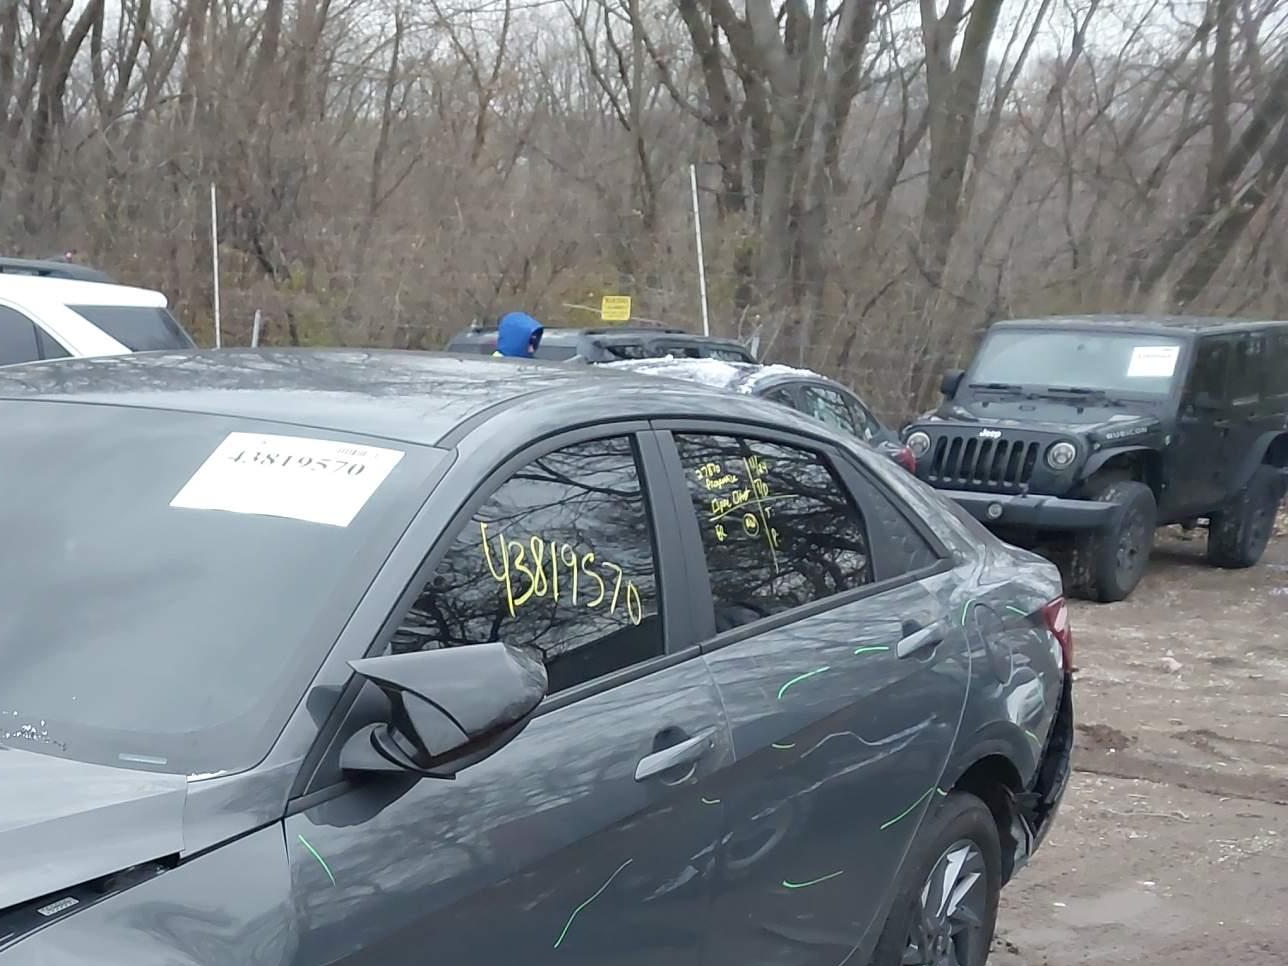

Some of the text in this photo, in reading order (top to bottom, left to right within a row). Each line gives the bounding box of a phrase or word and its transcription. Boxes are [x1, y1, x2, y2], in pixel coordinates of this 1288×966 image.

[979, 428, 1002, 440] Jeep
[1105, 427, 1148, 440] RUBICON
[226, 449, 367, 477] 43819570
[481, 521, 642, 626] 43819570
